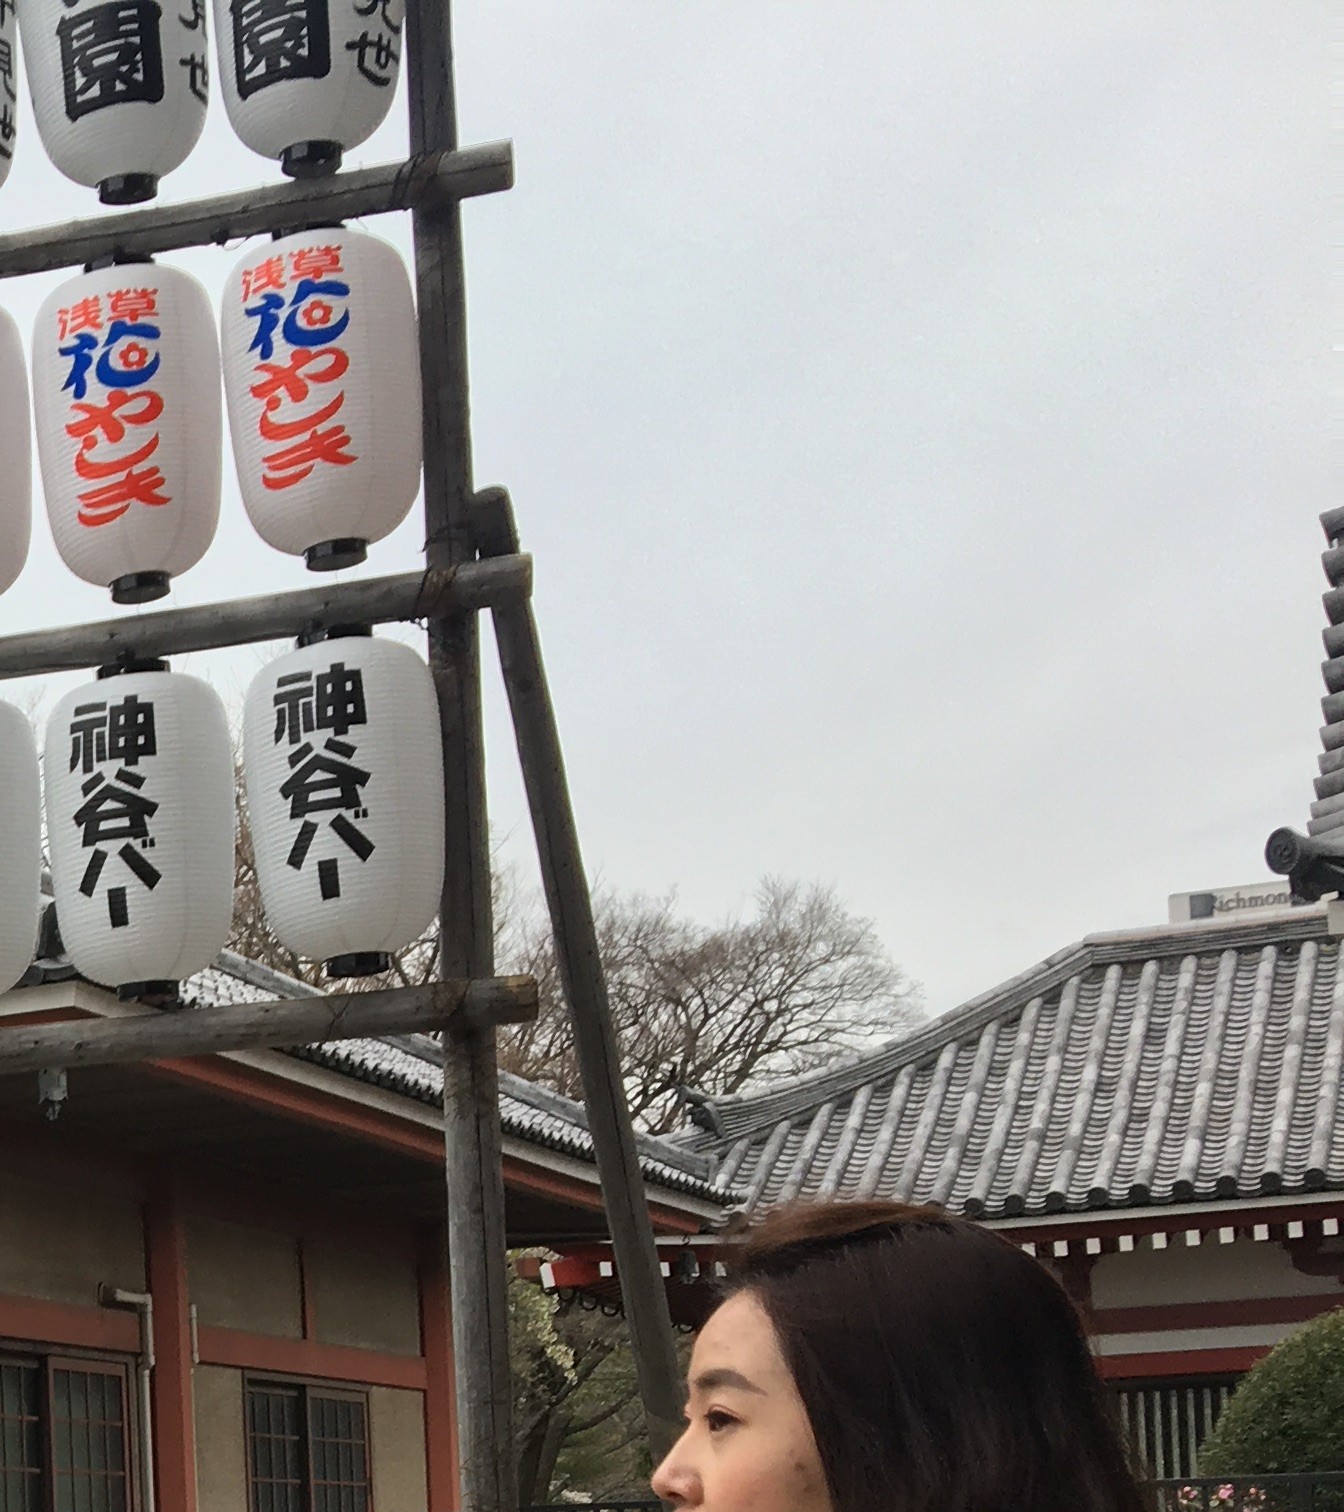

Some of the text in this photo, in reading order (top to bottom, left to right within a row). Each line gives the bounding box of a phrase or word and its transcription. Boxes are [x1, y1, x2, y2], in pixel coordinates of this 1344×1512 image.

[58, 289, 156, 339] 浅草
[242, 247, 342, 300] 浅草
[58, 321, 170, 528] 花やしき
[246, 279, 356, 491] 花やしき
[70, 695, 162, 928] 神谷バー
[274, 662, 375, 901] 神谷バー
